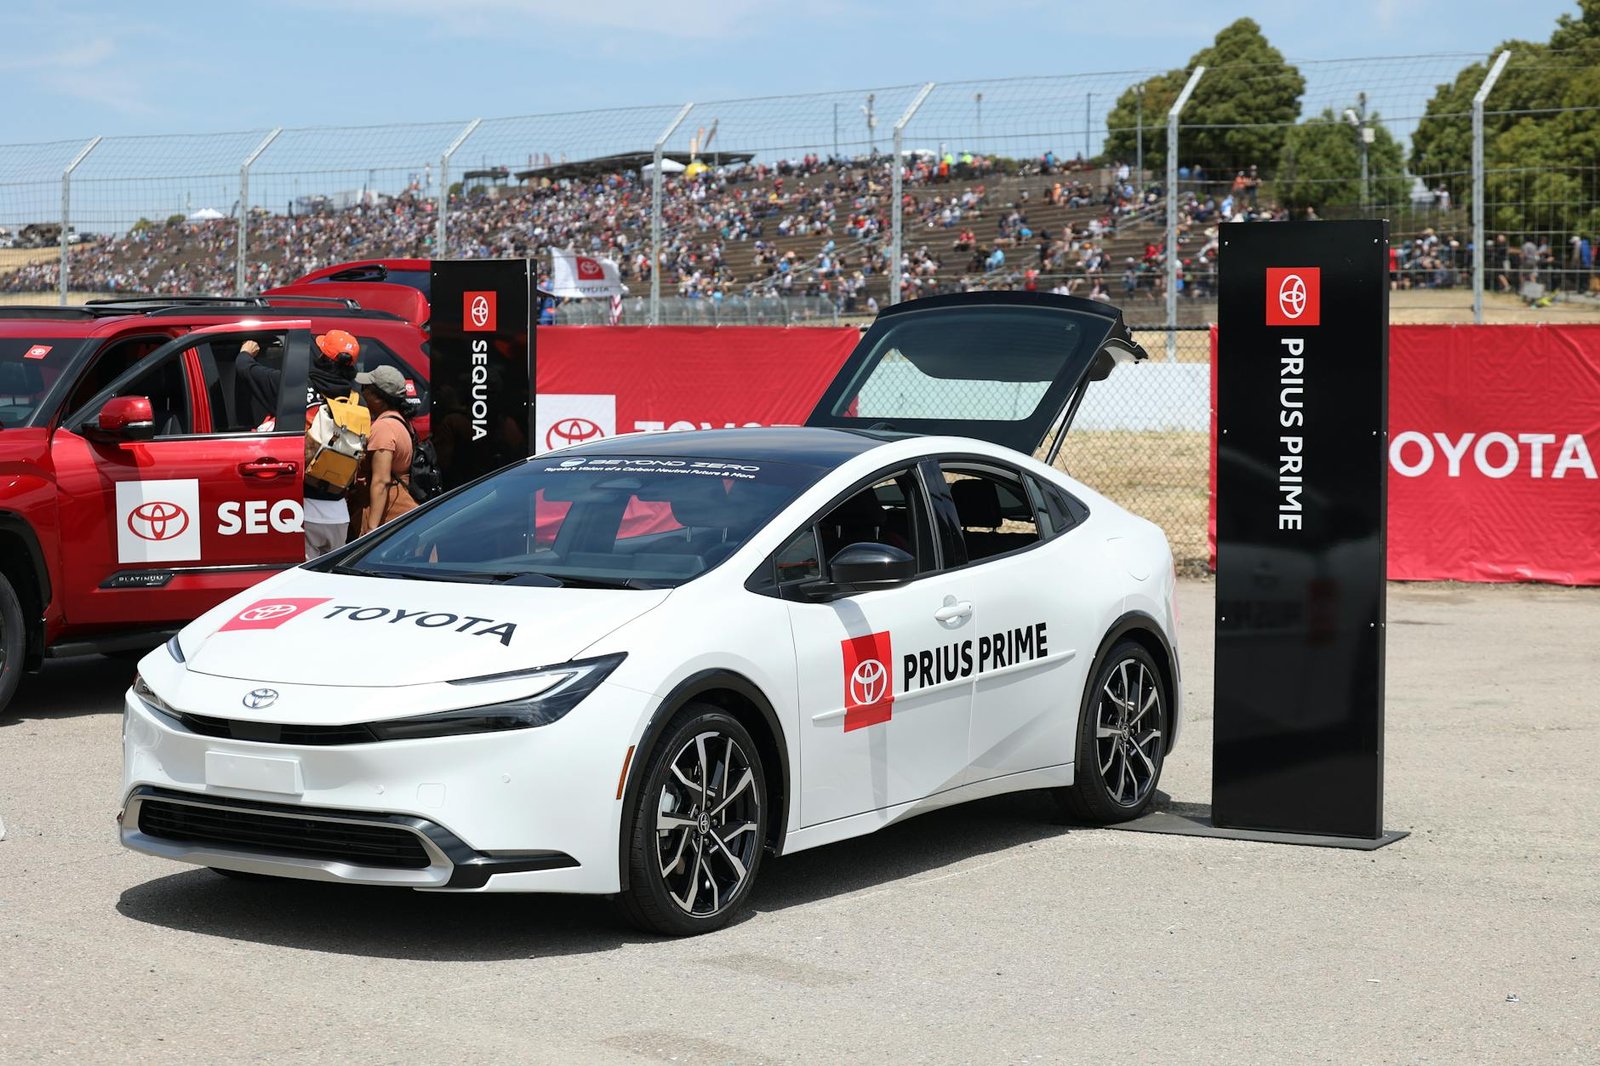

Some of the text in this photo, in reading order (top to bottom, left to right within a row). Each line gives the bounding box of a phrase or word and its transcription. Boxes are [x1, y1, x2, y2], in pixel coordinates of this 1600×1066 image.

[472, 340, 487, 441] SEQUOIA
[1279, 338, 1304, 530] PRIUS PRIME
[1388, 431, 1598, 479] OYOTA
[690, 461, 760, 471] ZERO
[217, 499, 304, 535] SEQ
[323, 605, 517, 647] TOYOTA
[903, 622, 1048, 692] PRIUS PRIME
